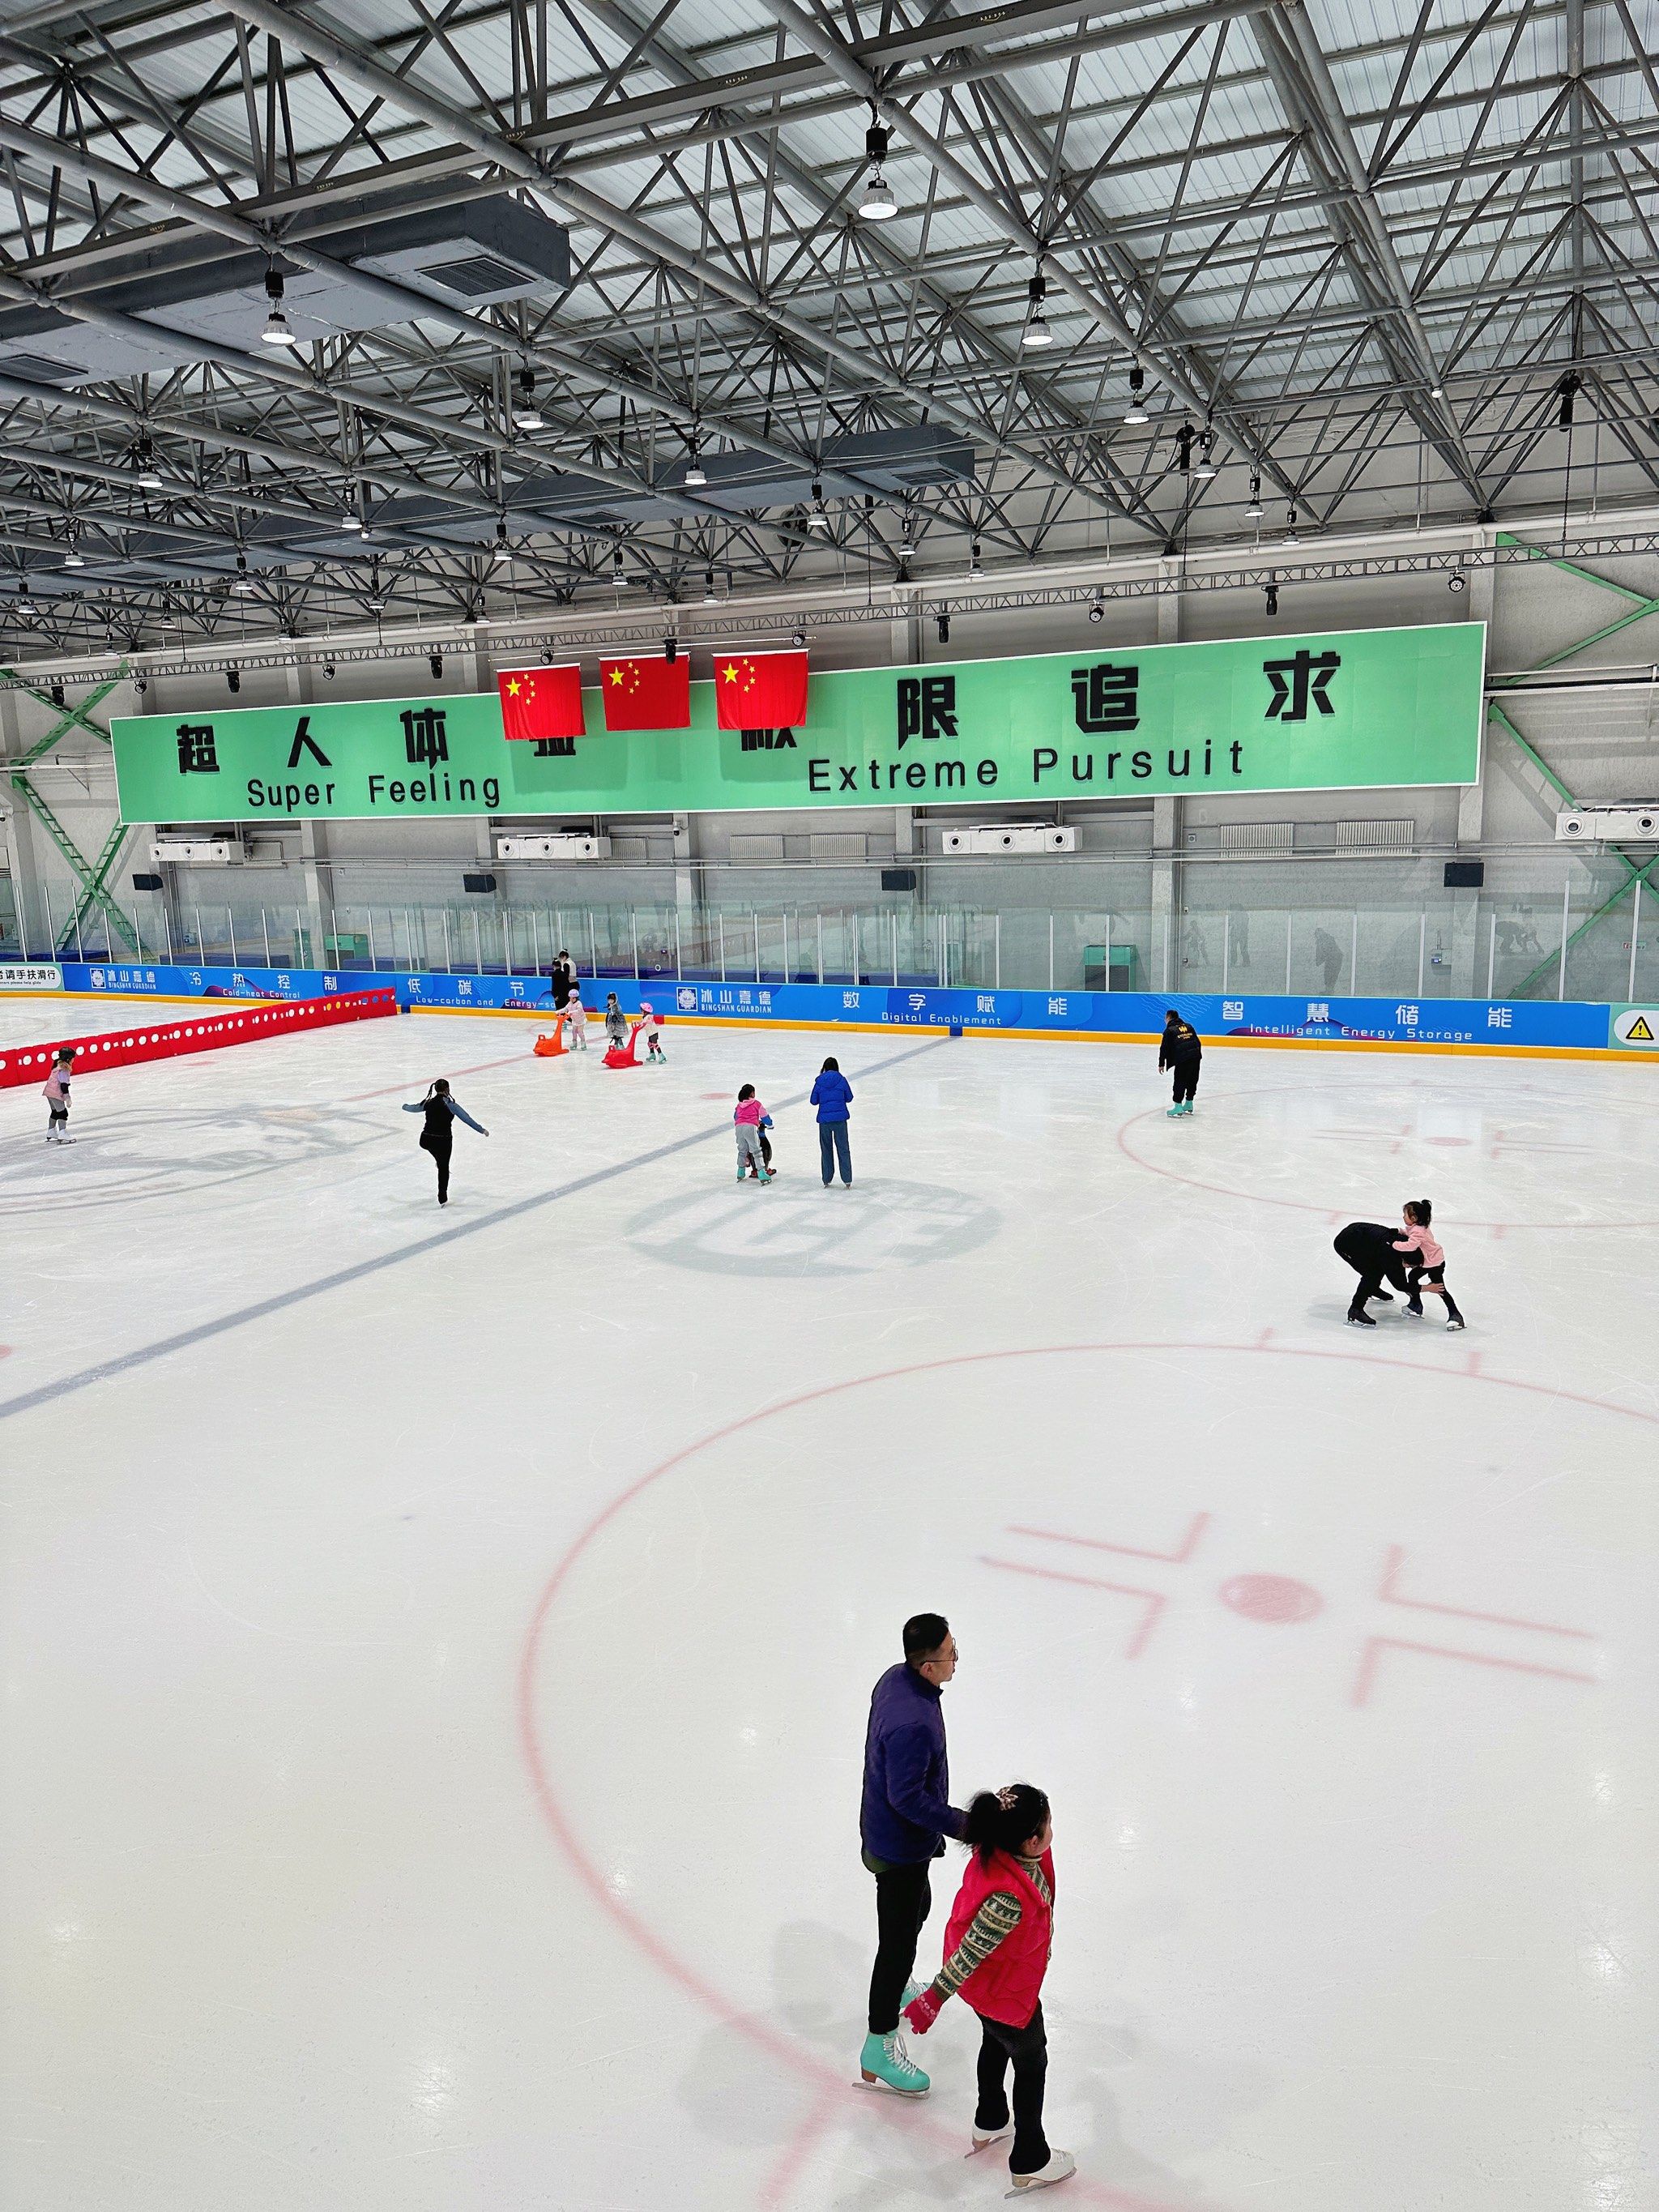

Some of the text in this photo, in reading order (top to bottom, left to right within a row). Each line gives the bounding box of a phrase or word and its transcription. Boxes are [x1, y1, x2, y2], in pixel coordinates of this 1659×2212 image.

[176, 707, 576, 775] 超人体
[247, 740, 1243, 813] Super Feeling Extreme Pursuit
[108, 981, 156, 990] BINGSHAN GUARDIAN
[190, 971, 337, 991] 冷热控制
[223, 989, 301, 998] Cold-heat Control
[416, 995, 557, 1009] Low-carbon and Energy-sa
[701, 989, 771, 1005] 冰山嘉德
[701, 1004, 772, 1014] BINGSHAN GUARDIAN
[842, 991, 1068, 1015] 数字赋能
[881, 1012, 1001, 1025] Digital Enablement
[1222, 1001, 1512, 1028] 智慧储能
[1250, 1023, 1473, 1041] Intelligent Energy Storage
